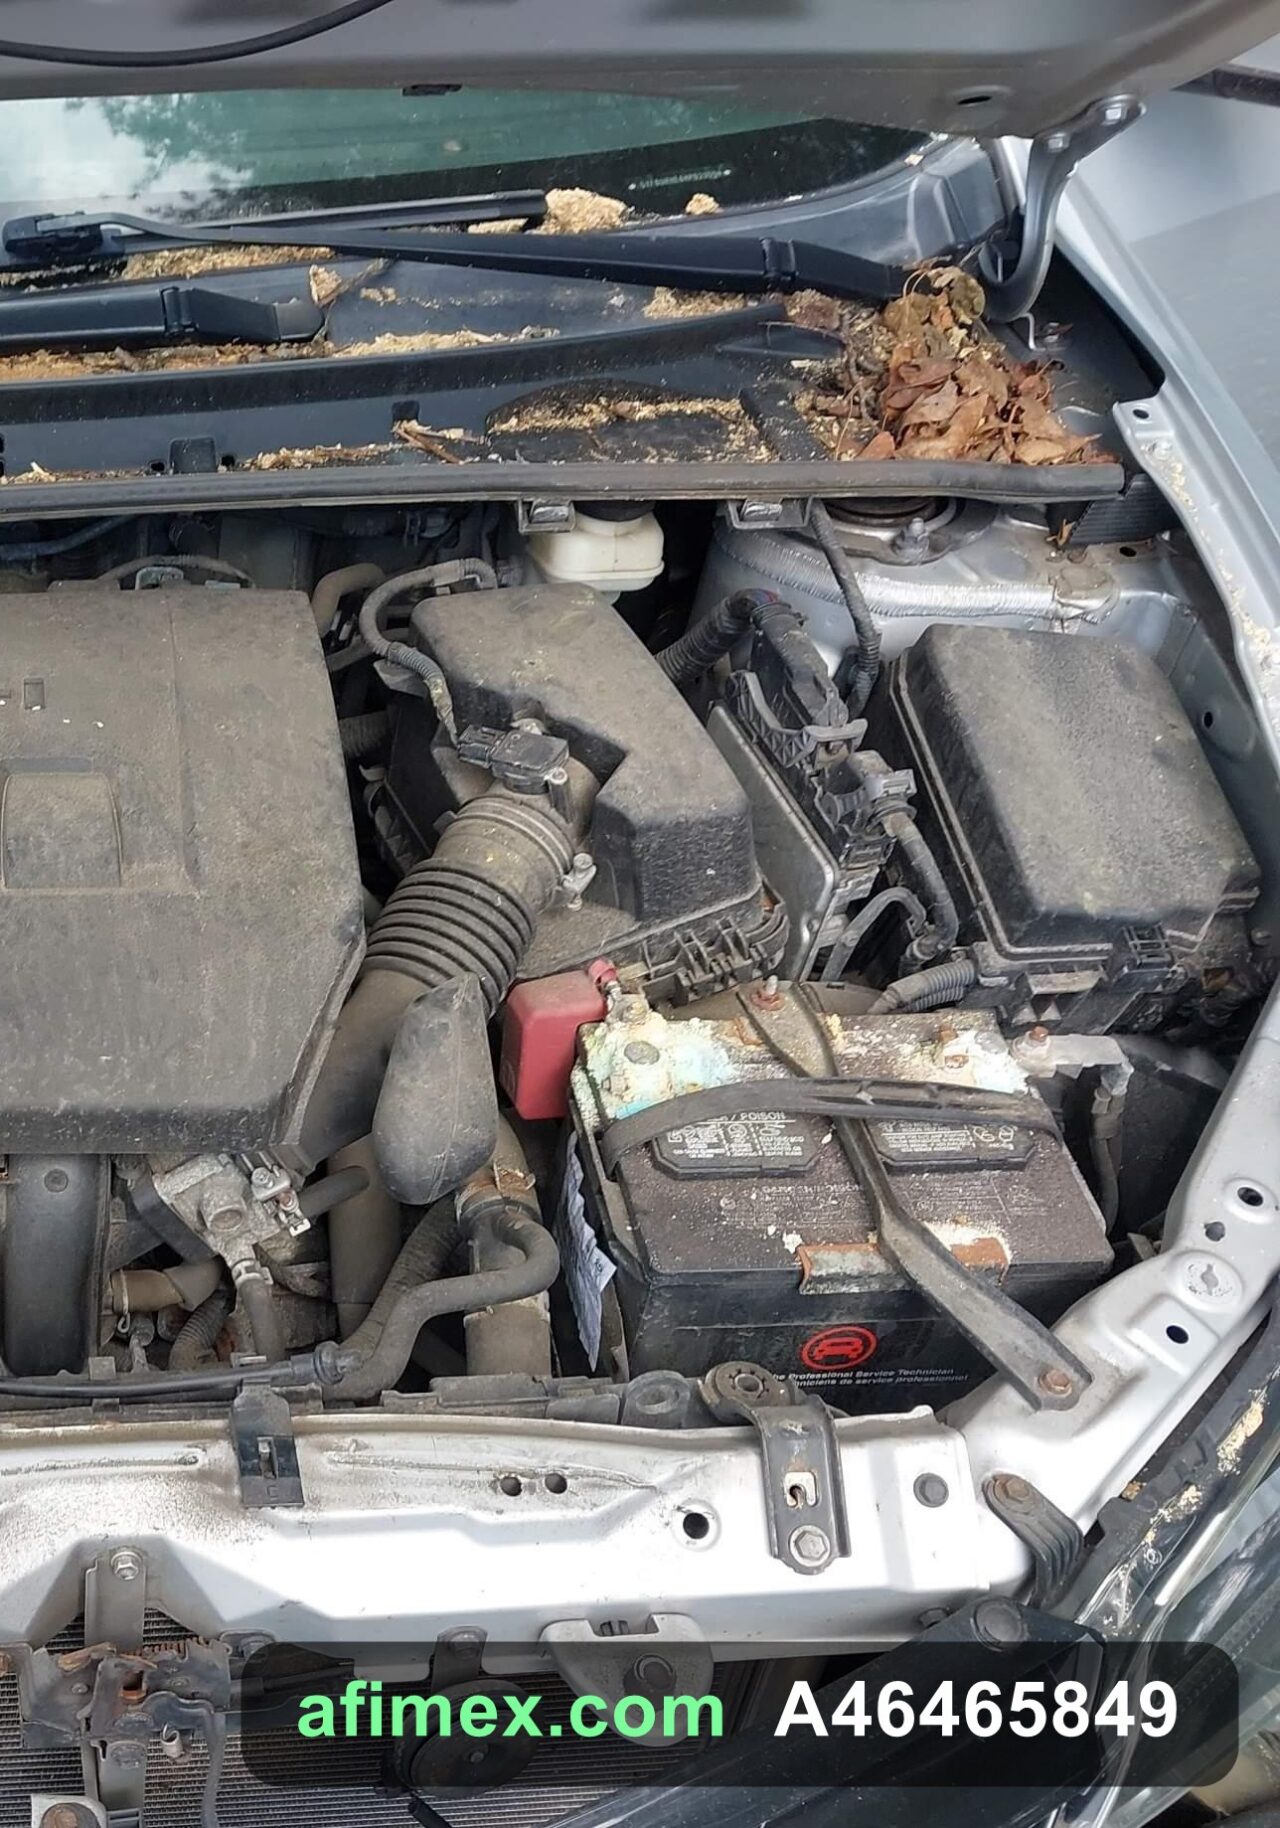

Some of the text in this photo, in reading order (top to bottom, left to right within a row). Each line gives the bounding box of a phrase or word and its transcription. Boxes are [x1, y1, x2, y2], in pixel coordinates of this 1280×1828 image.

[740, 1111, 786, 1121] POISON
[772, 1368, 954, 1381] he Professional Service Technician
